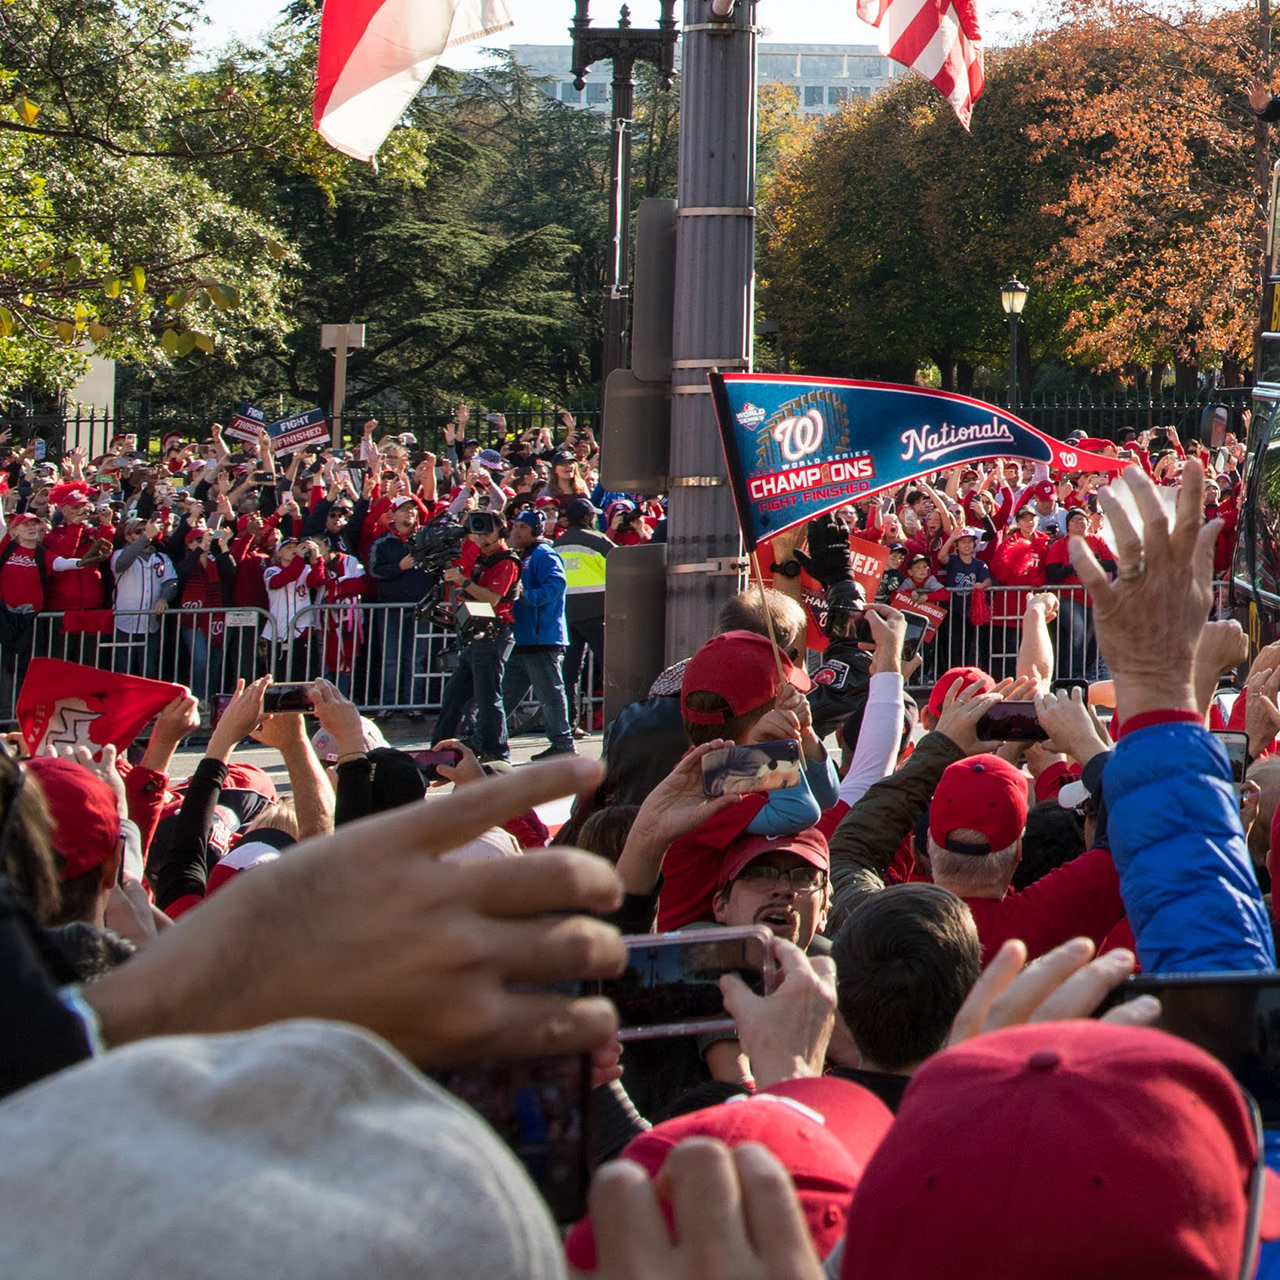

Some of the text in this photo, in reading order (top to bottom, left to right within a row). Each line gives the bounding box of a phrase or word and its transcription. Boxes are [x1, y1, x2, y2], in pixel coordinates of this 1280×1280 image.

[275, 425, 323, 448] FINISHED
[279, 414, 310, 433] FIGHT
[900, 416, 1014, 462] Nationals
[781, 457, 821, 471] WORLD
[826, 450, 870, 462] SERIES
[750, 458, 873, 500] CHAMPIONS
[758, 480, 869, 514] FIGHT FINISHED
